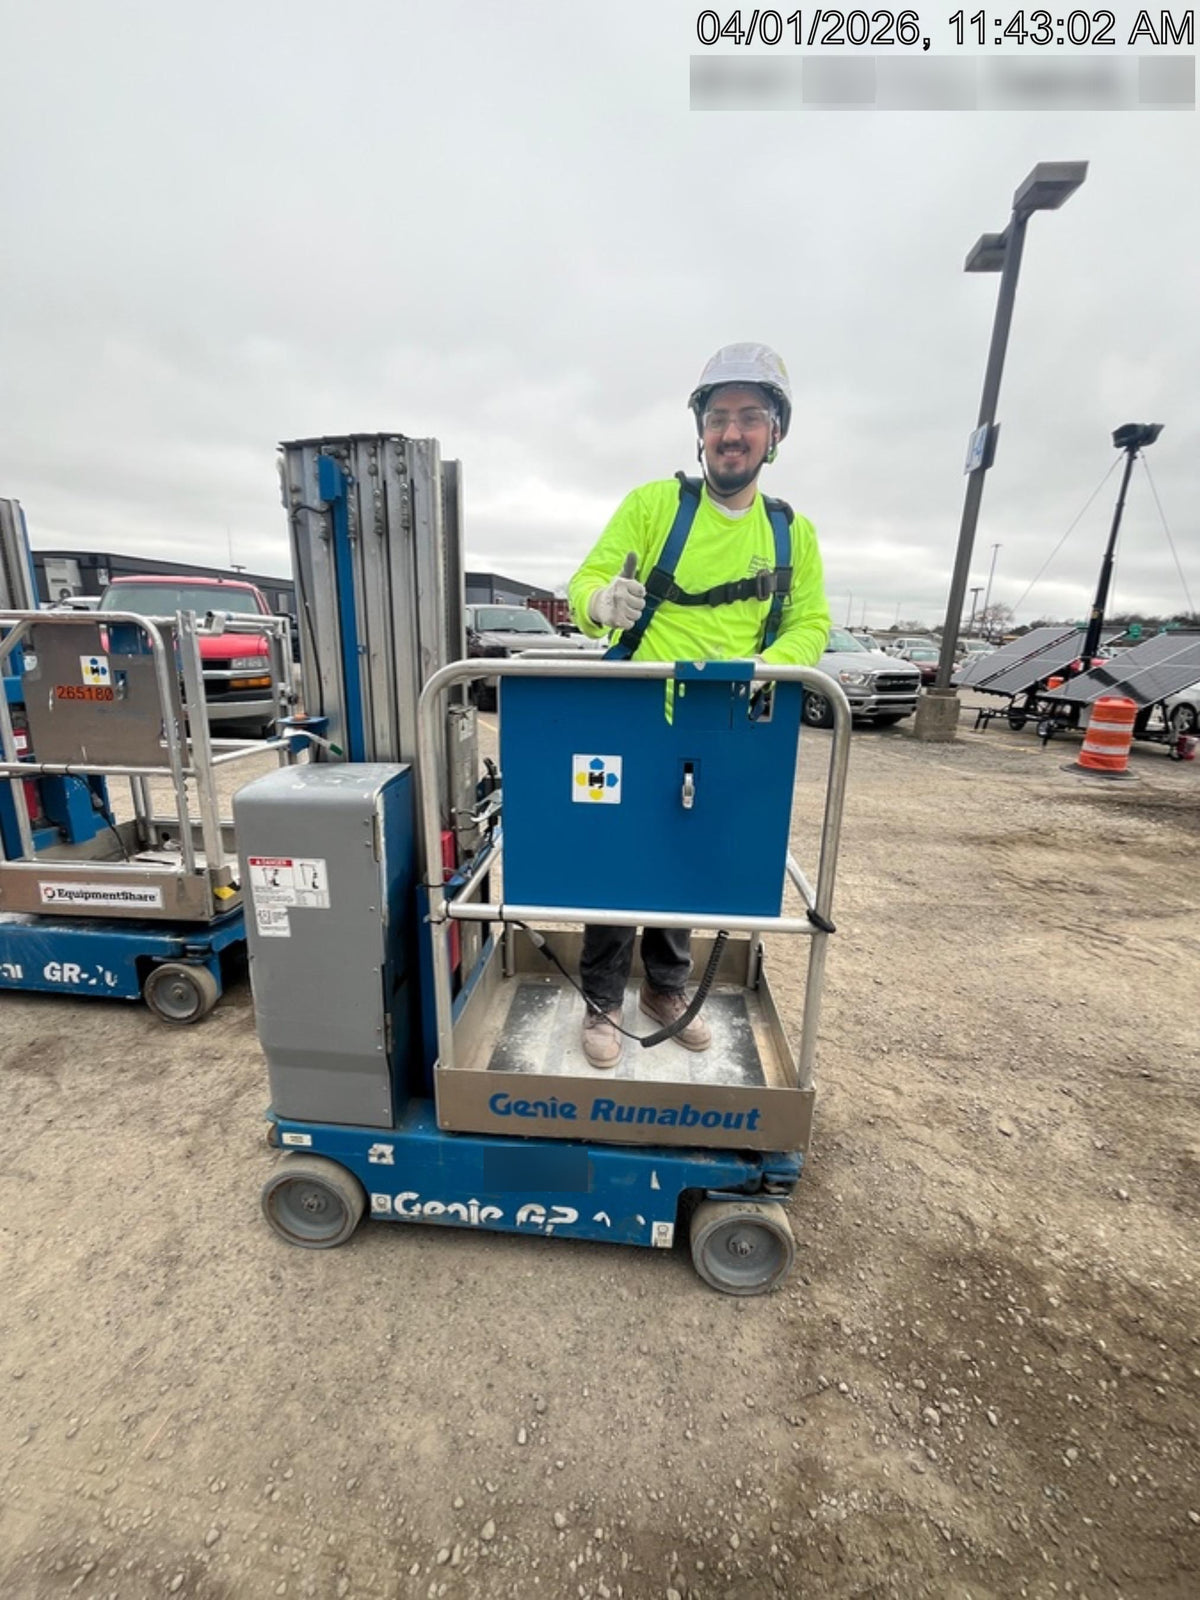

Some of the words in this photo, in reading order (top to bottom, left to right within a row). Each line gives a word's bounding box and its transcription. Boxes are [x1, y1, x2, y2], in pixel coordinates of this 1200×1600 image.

[57, 888, 157, 902] EquipmentShare
[43, 961, 118, 987] GR-
[489, 1092, 578, 1120] Genie
[590, 1098, 760, 1131] Runabout
